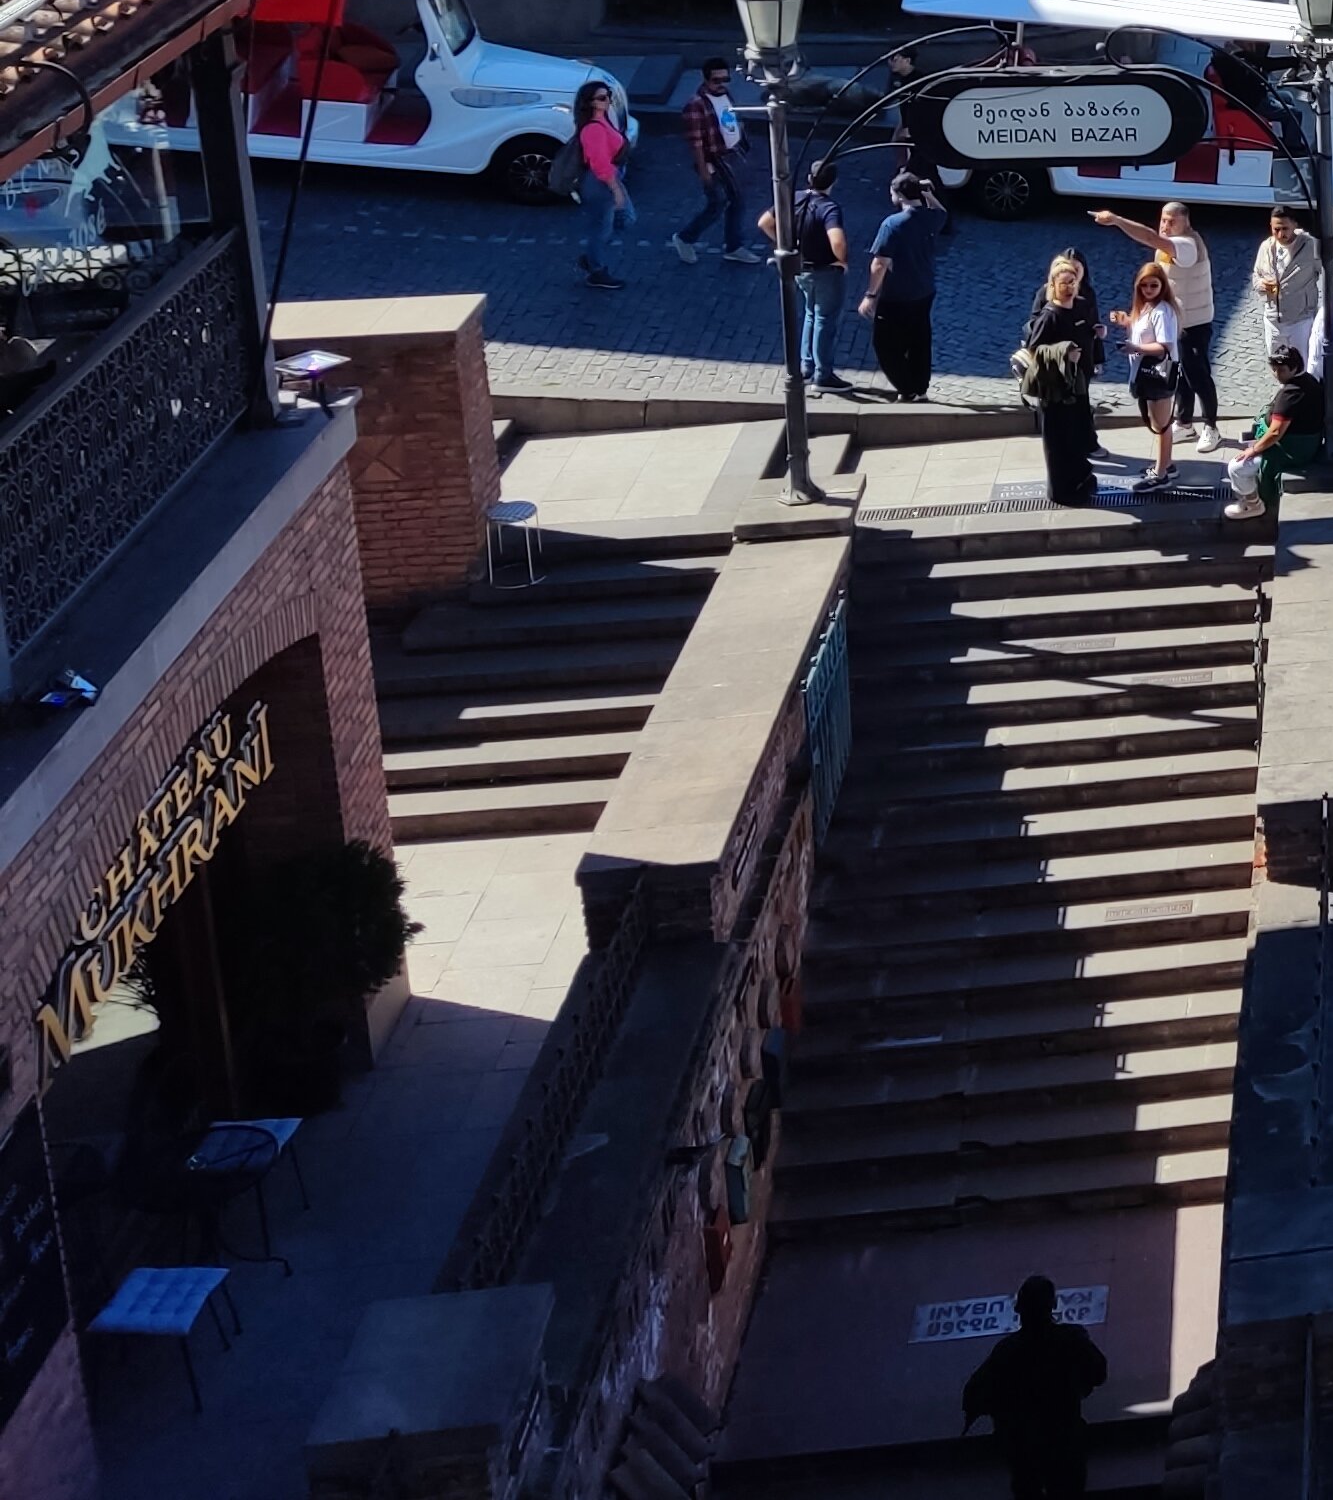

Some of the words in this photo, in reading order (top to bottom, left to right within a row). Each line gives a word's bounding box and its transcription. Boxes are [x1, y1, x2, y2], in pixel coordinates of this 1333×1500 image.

[973, 101, 1051, 124] მეიდან
[1064, 100, 1141, 118] ბაზარი
[978, 128, 1056, 144] MEIDAN
[1071, 127, 1138, 142] BAZAR
[80, 711, 233, 943] CHÂTEAU
[36, 704, 275, 1095] MUKHRANI
[929, 1300, 1005, 1321] UBANI
